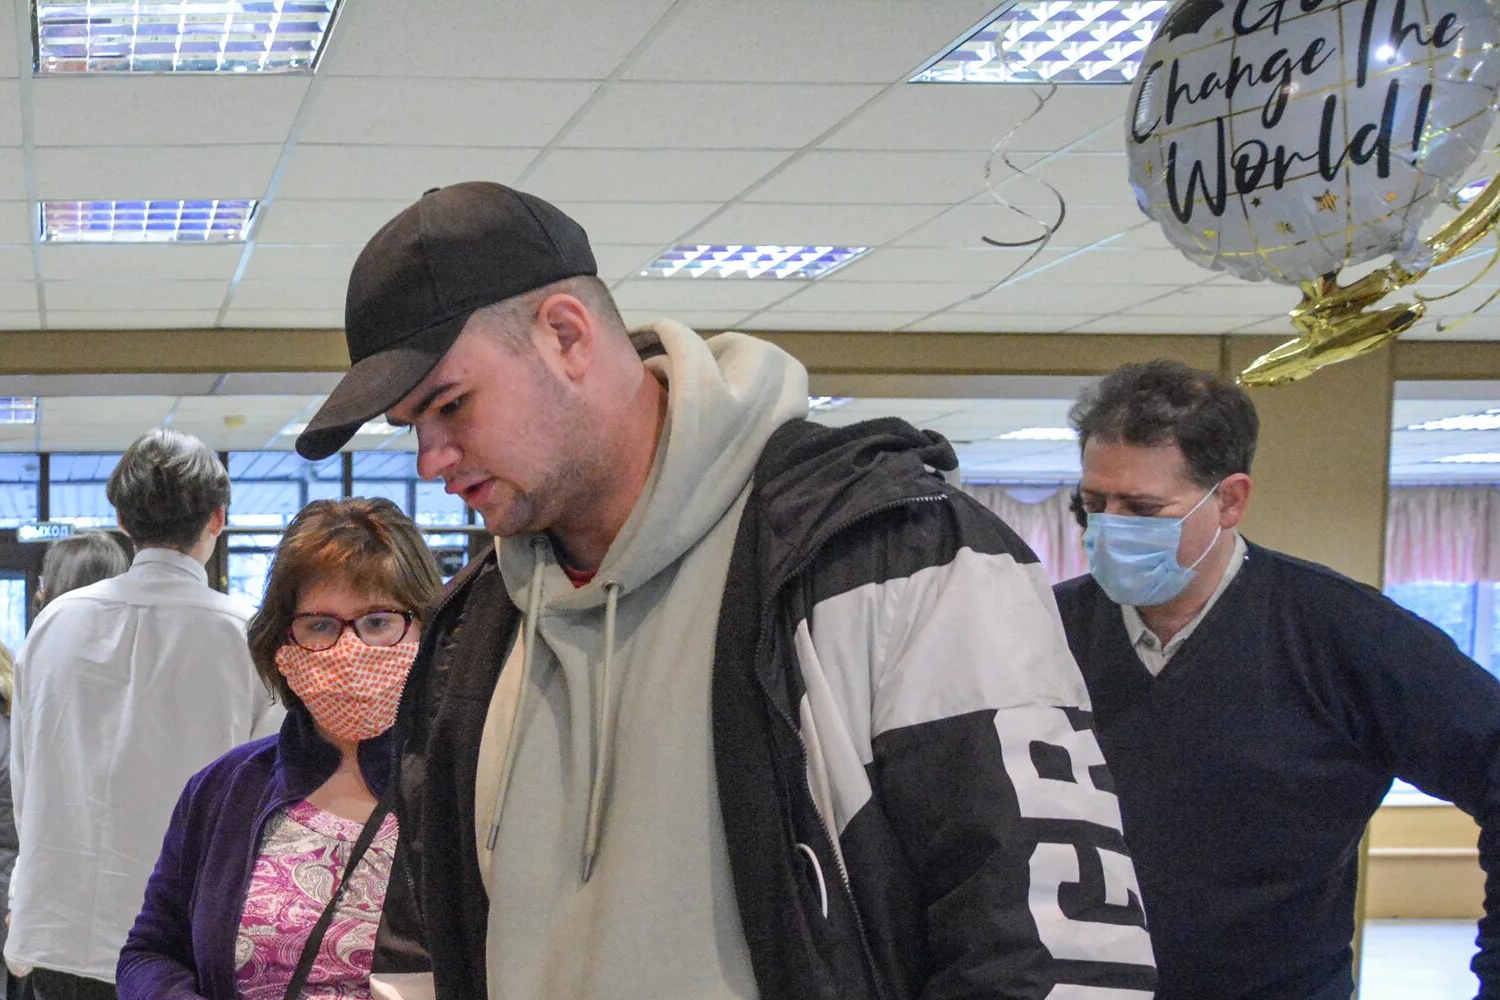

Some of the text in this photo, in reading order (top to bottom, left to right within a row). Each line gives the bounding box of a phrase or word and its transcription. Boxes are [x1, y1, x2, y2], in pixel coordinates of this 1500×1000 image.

[1131, 36, 1336, 144] Change
[1165, 79, 1432, 224] World!
[21, 525, 69, 538] ЫХОД
